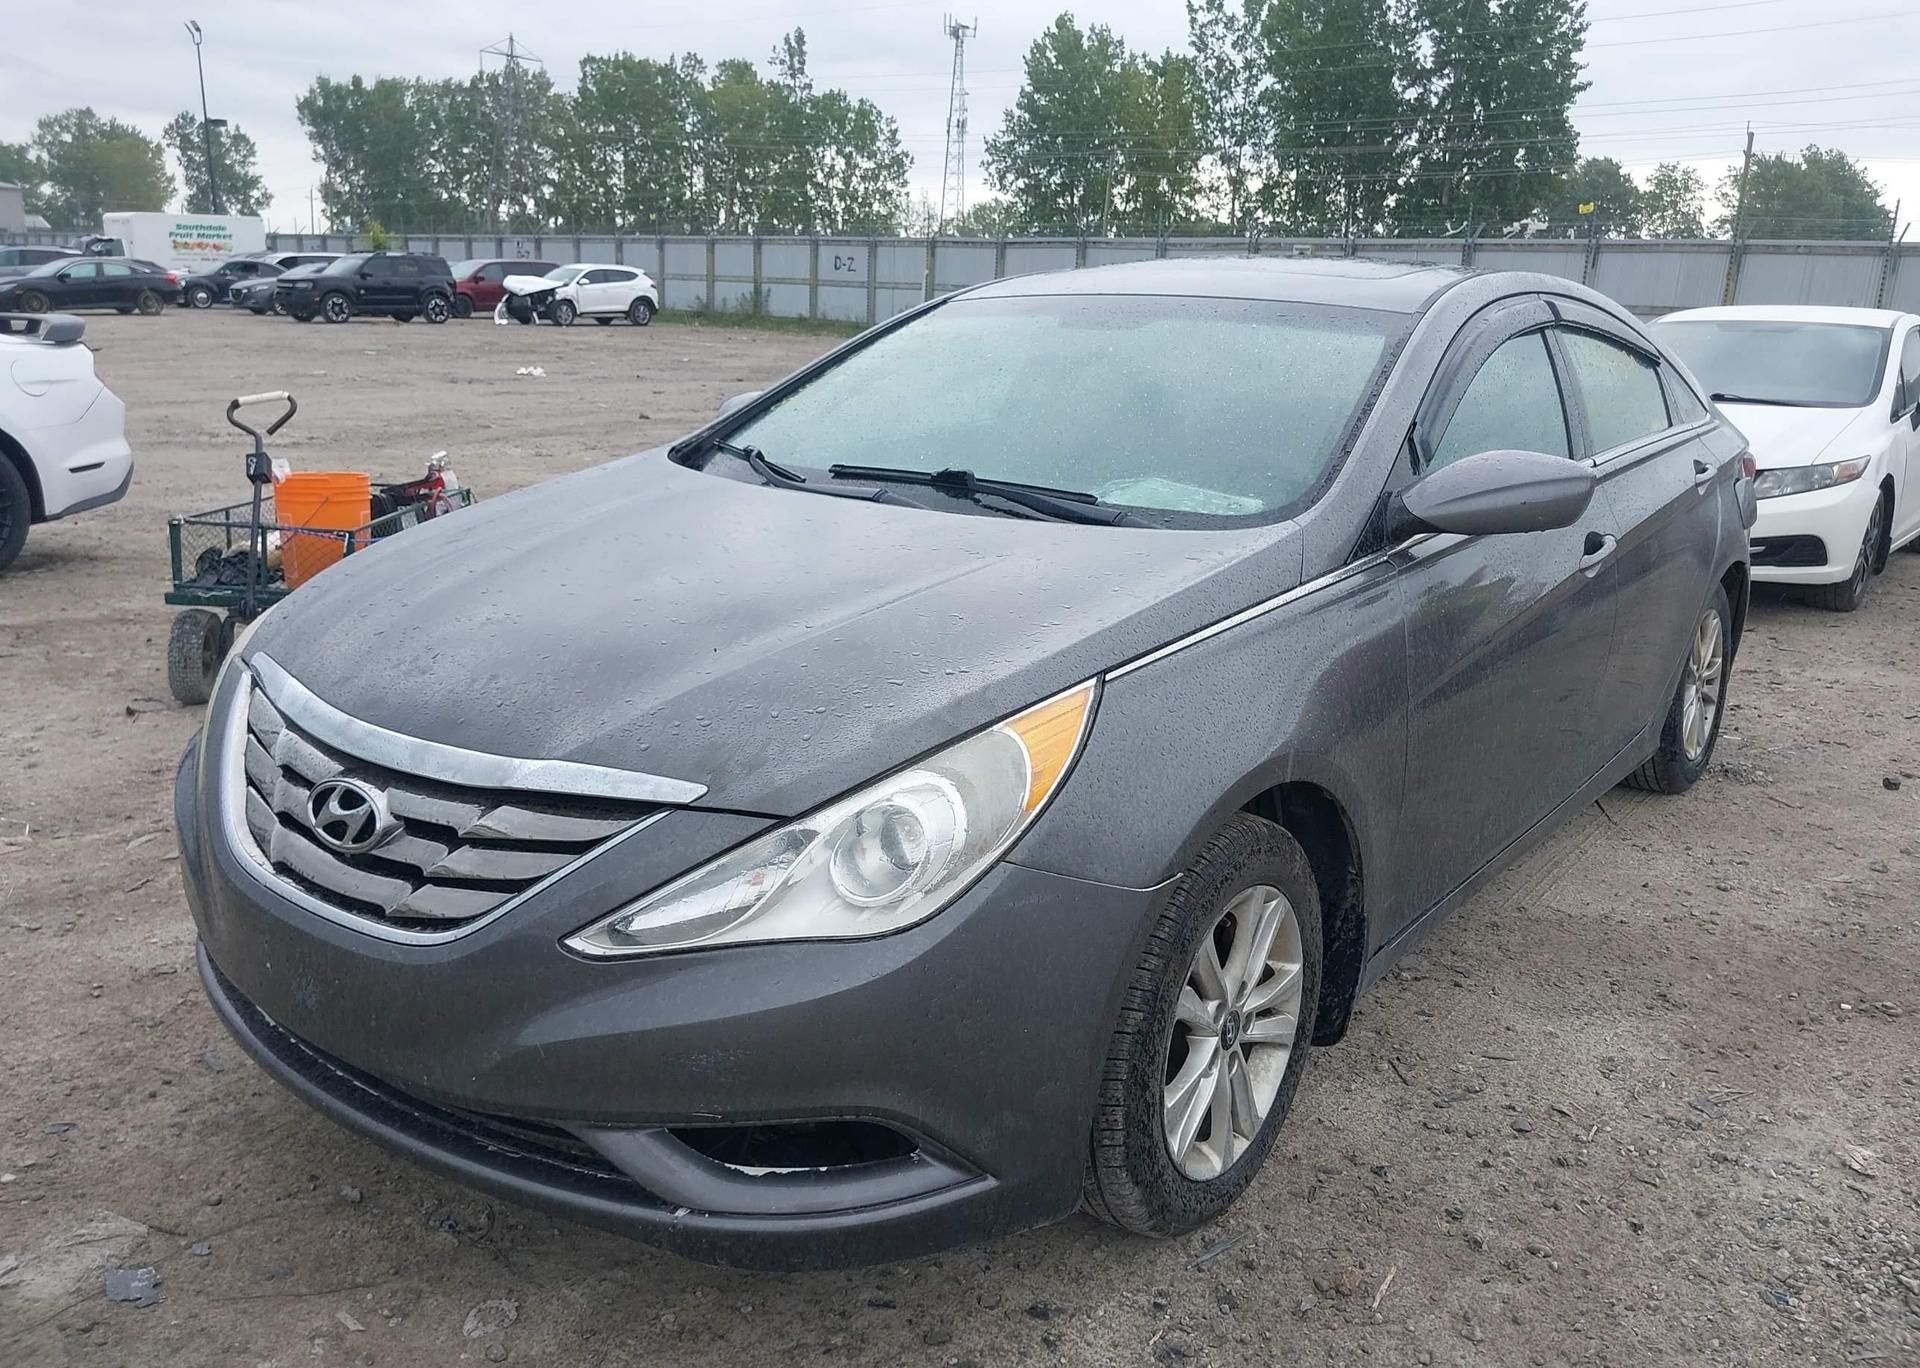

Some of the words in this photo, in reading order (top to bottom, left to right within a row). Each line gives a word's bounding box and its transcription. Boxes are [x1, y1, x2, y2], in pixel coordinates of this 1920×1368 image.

[176, 223, 227, 231] Southdale
[169, 231, 193, 239] Fruit
[197, 232, 232, 240] Market
